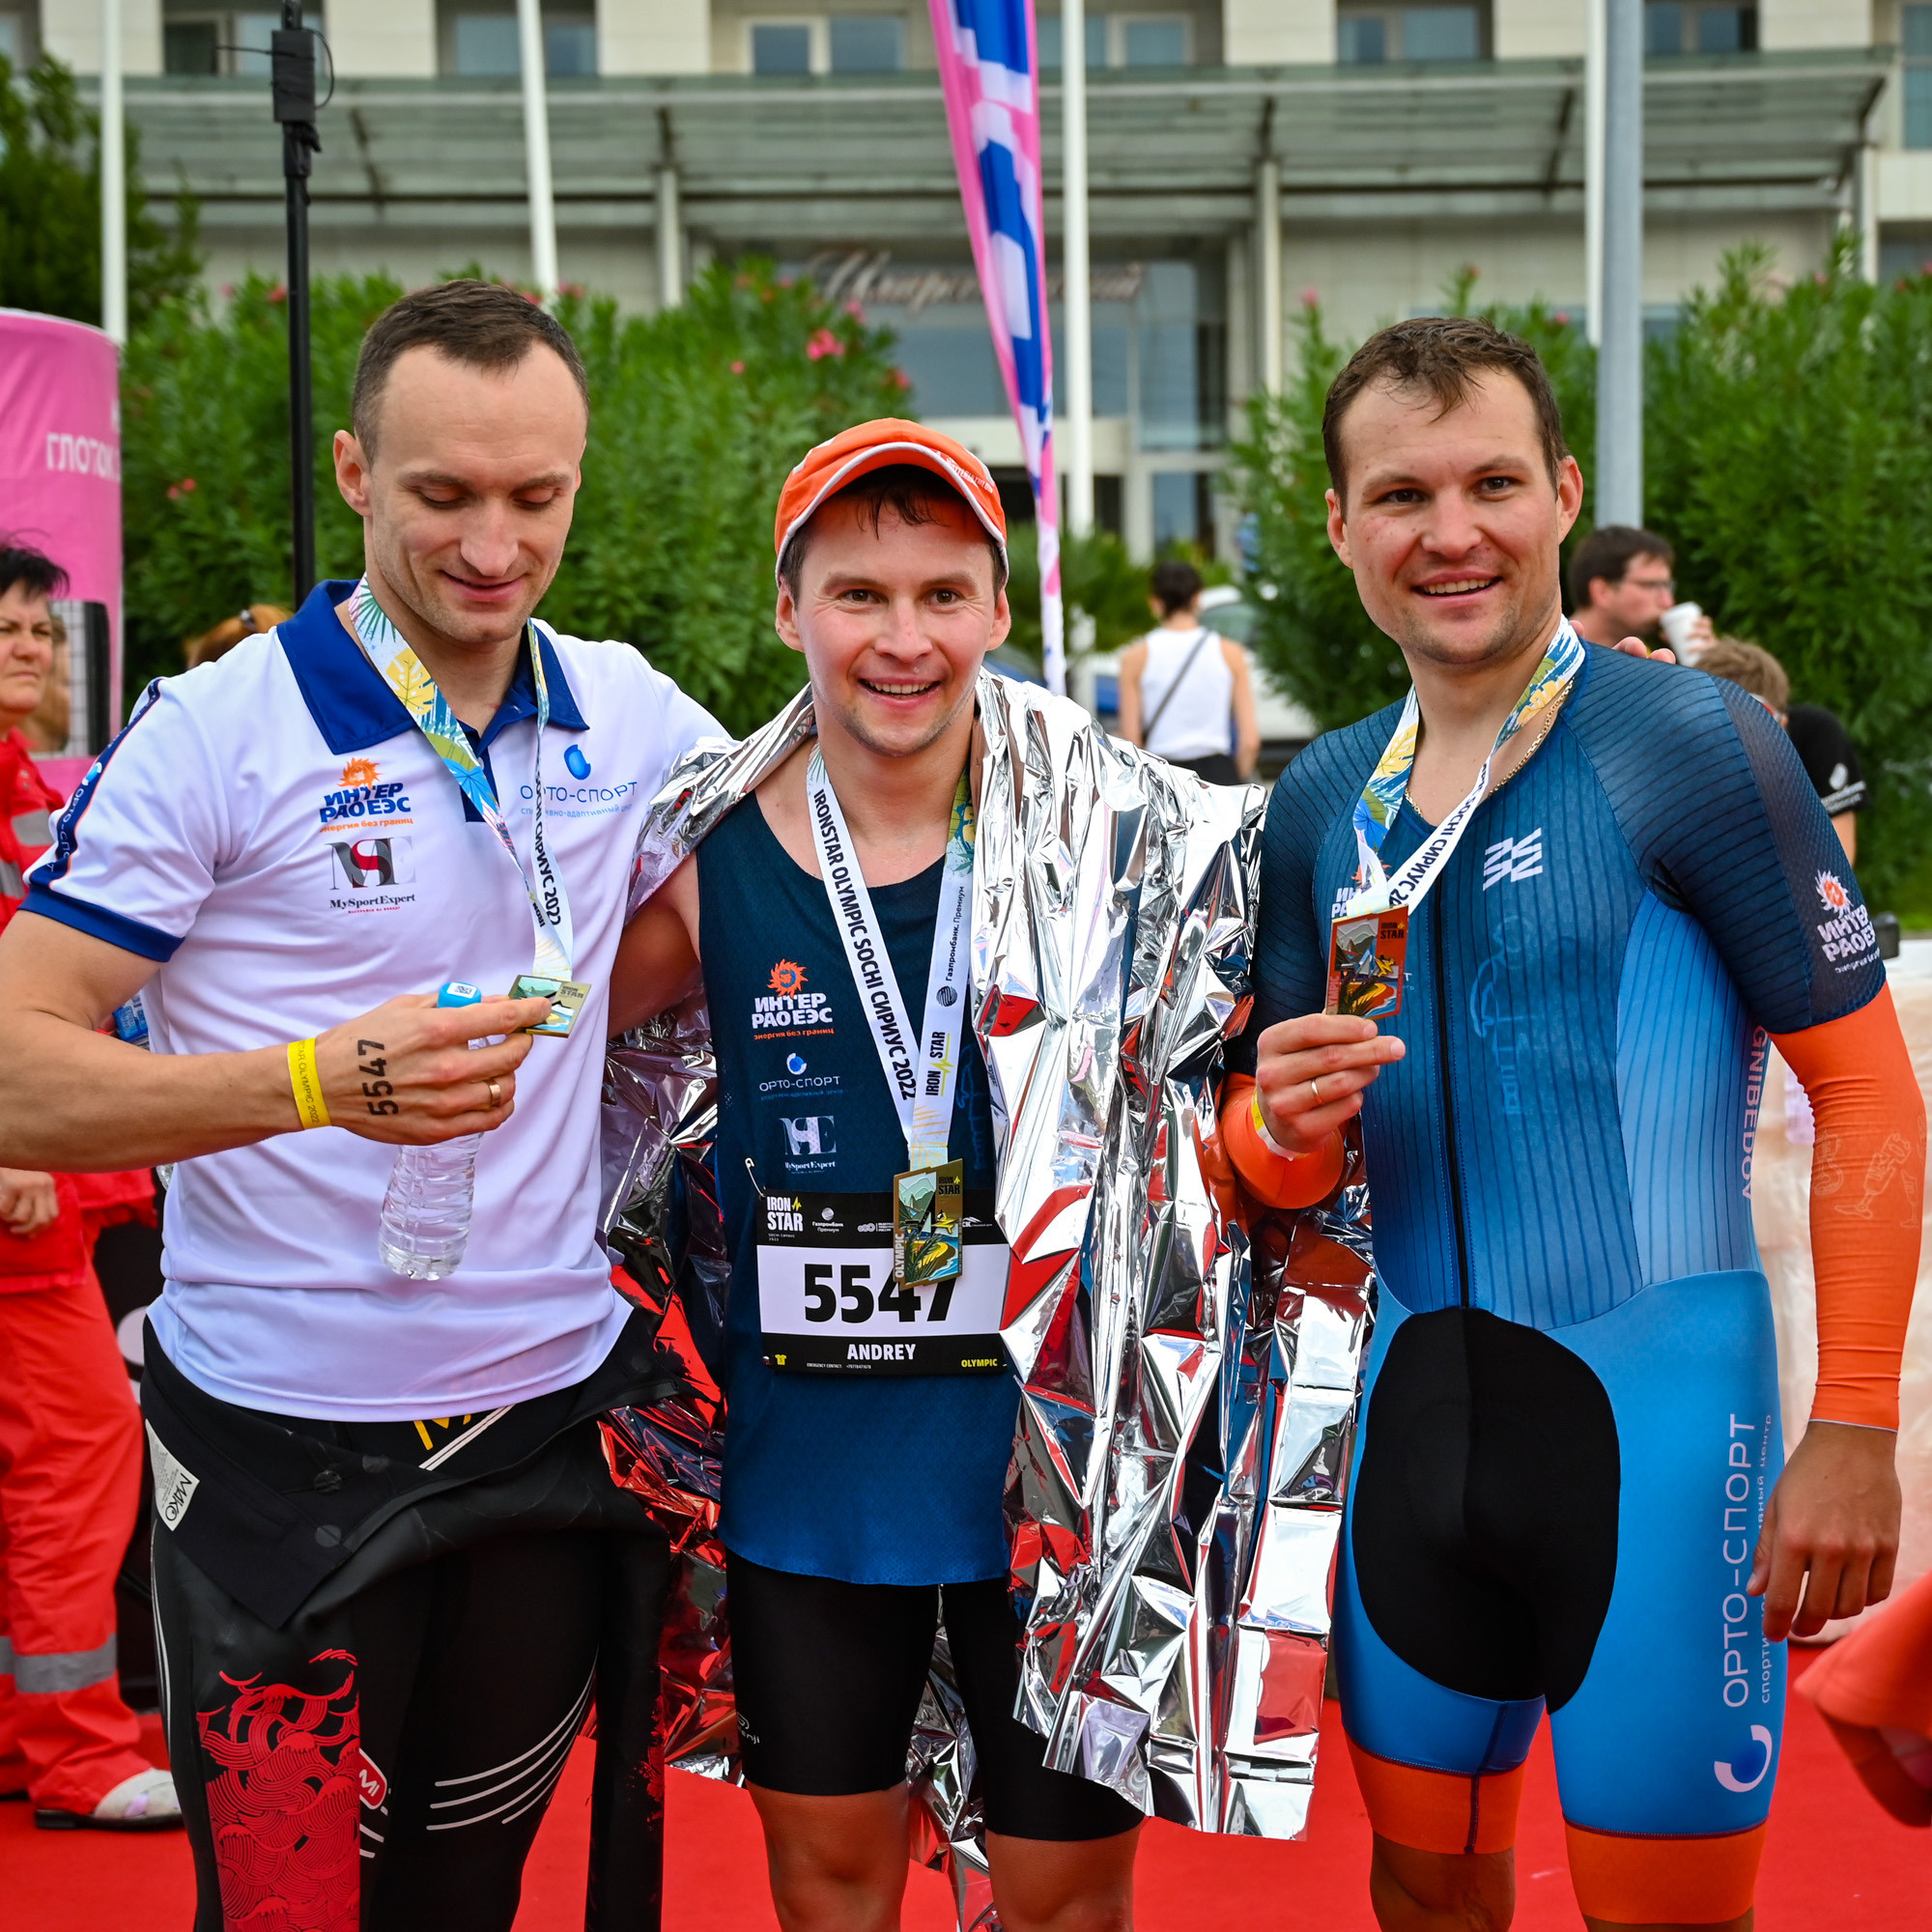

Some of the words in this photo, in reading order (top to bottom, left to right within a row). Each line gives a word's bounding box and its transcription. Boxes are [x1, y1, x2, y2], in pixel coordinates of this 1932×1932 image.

[324, 782, 404, 807] ИНТЕР
[520, 781, 638, 803] ОТО-СПОРТ
[380, 818, 414, 827] границ
[329, 895, 416, 910] MySportExpert
[953, 886, 965, 923] Премиум
[813, 788, 844, 866] IRONSTAR
[832, 867, 867, 938] OLYMPIC
[853, 937, 884, 990] SOCHI
[892, 1058, 917, 1101] 2022
[1380, 929, 1405, 939] STAR
[754, 992, 827, 1012] ИНТЕР
[929, 1031, 946, 1059] STAR
[357, 1038, 399, 1116] 5547
[758, 1075, 841, 1092] ОРТО-СПОРТ
[925, 1070, 941, 1096] IRON
[938, 1184, 960, 1195] STAR
[766, 1196, 791, 1211] IRON
[767, 1211, 804, 1232] STAR
[895, 1233, 905, 1279] OLYMPIC
[804, 1264, 957, 1323] 5547
[847, 1344, 917, 1360] ANDREY
[961, 1358, 998, 1368] OLYMPIC
[1722, 1413, 1755, 1708] ОРТО-СПОРТ
